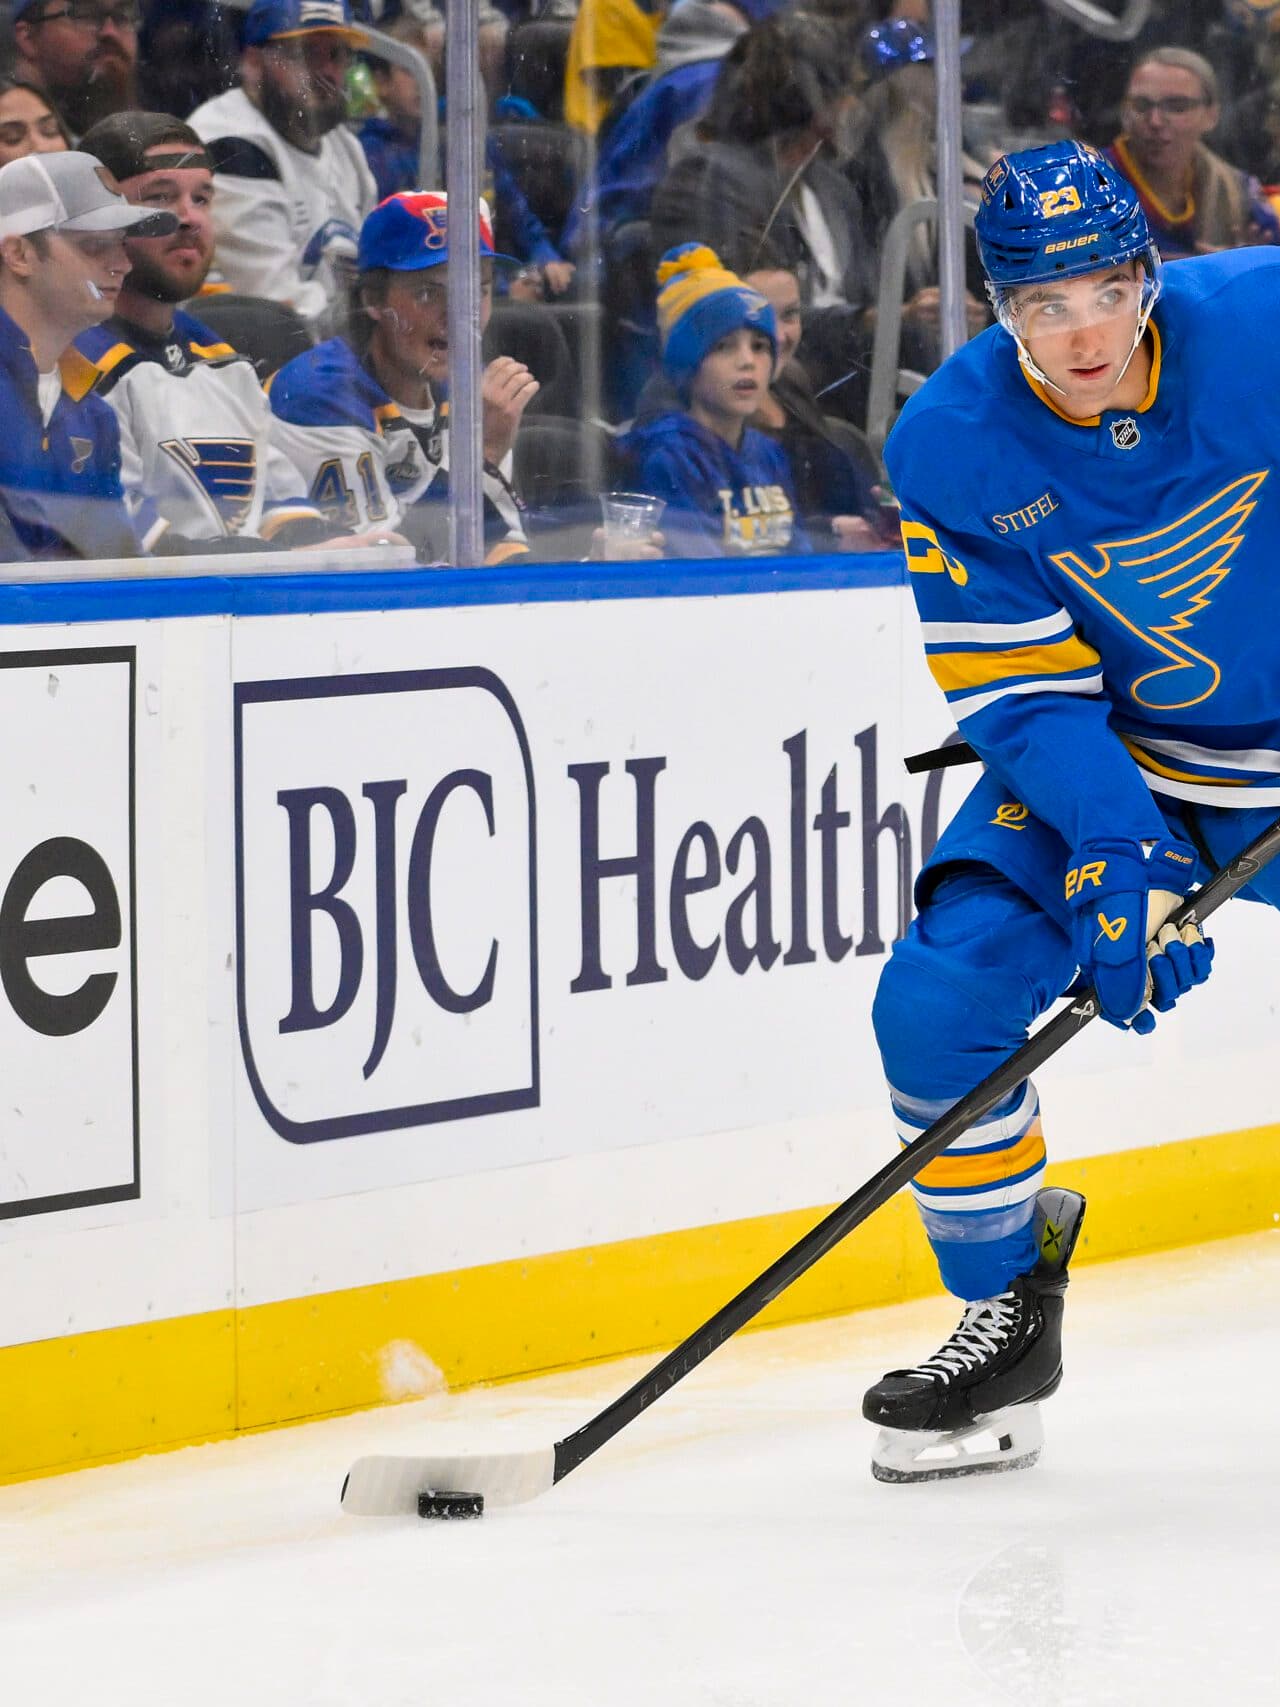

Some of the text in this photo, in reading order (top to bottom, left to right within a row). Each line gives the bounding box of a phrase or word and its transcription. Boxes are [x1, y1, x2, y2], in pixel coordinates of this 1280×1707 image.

[1039, 185, 1082, 219] 23
[310, 451, 388, 527] 41
[992, 493, 1059, 534] STIFEL
[277, 768, 499, 1080] BJC
[640, 1327, 730, 1408] FLYLITE
